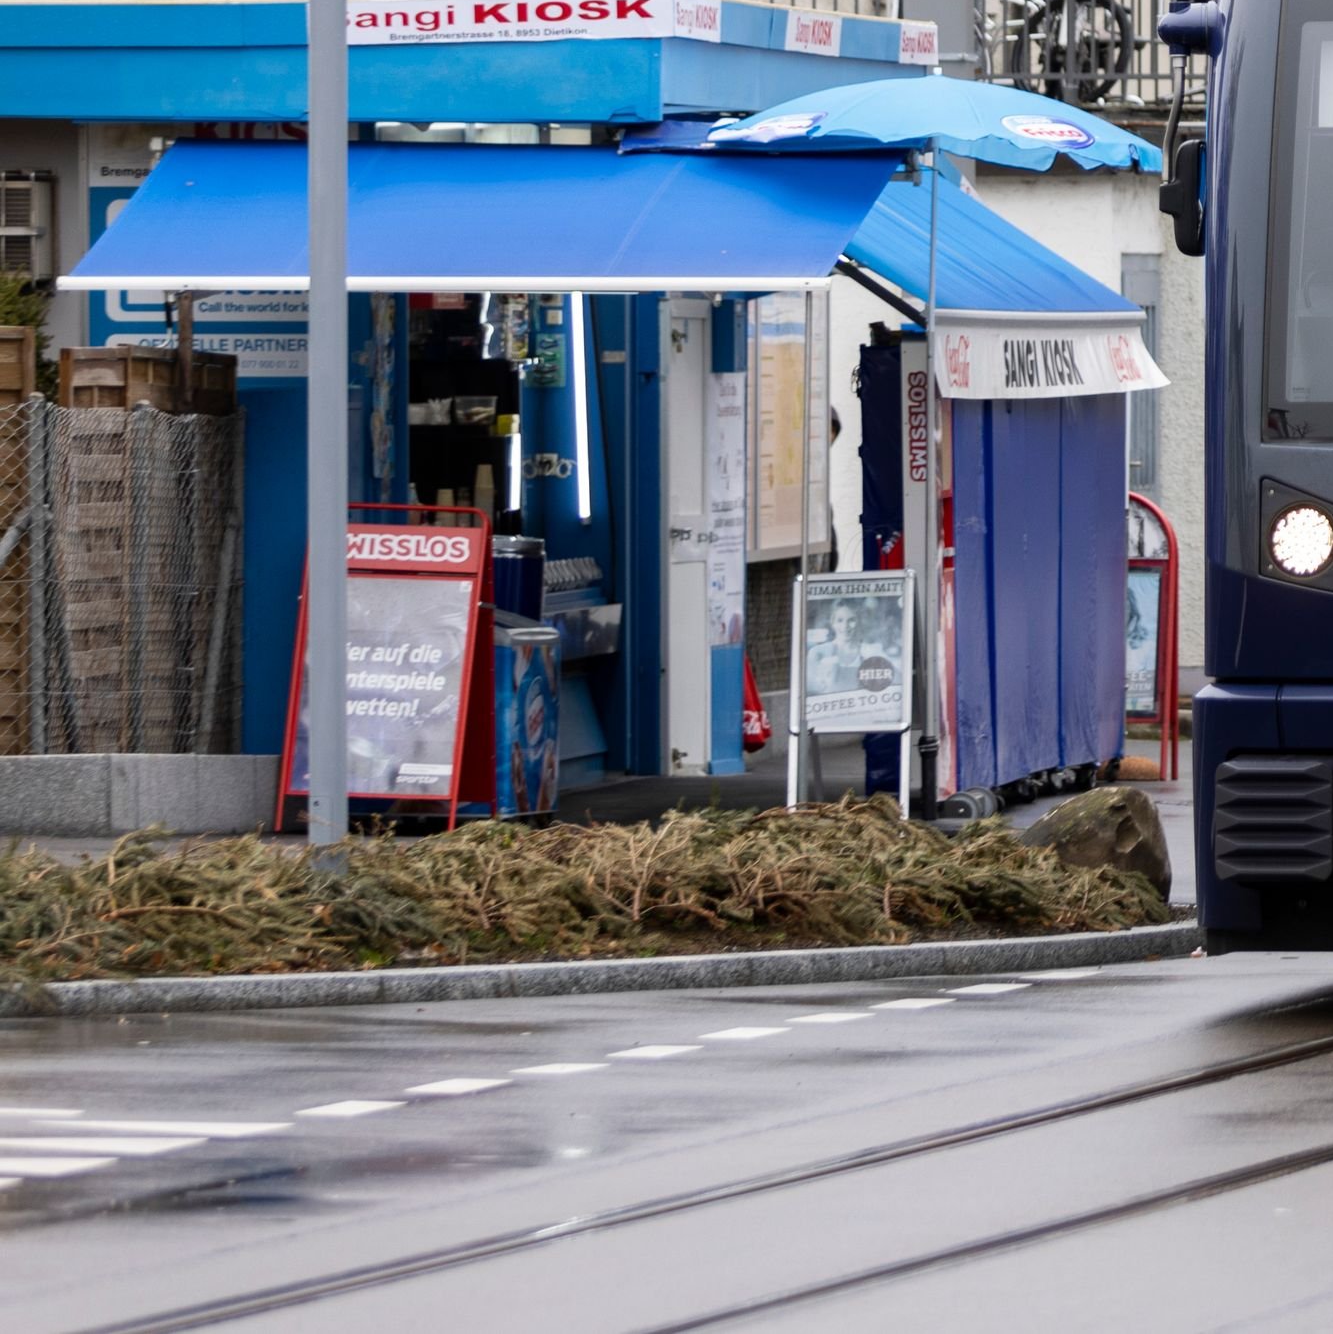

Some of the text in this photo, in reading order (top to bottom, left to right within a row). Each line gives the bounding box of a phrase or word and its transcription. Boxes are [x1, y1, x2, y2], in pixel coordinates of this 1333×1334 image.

[346, 5, 455, 32] angi
[695, 4, 719, 31] KIOSK
[389, 27, 493, 41] Bremgartnerstrasse
[811, 19, 834, 47] KIOSK
[917, 32, 936, 55] KIOSK
[198, 301, 222, 313] Call
[224, 301, 244, 313] the
[246, 301, 280, 313] world
[233, 338, 309, 352] PARTNER
[1003, 338, 1085, 388] SANGI KIOSK
[908, 370, 928, 483] SWISSLOS
[346, 533, 470, 563] WISSLOS
[371, 642, 411, 667] auf
[409, 644, 443, 664] die
[346, 670, 447, 693] nterspiele
[859, 667, 893, 681] HIER
[805, 697, 857, 715] COFFEE
[858, 693, 878, 707] TO
[880, 691, 903, 704] GO
